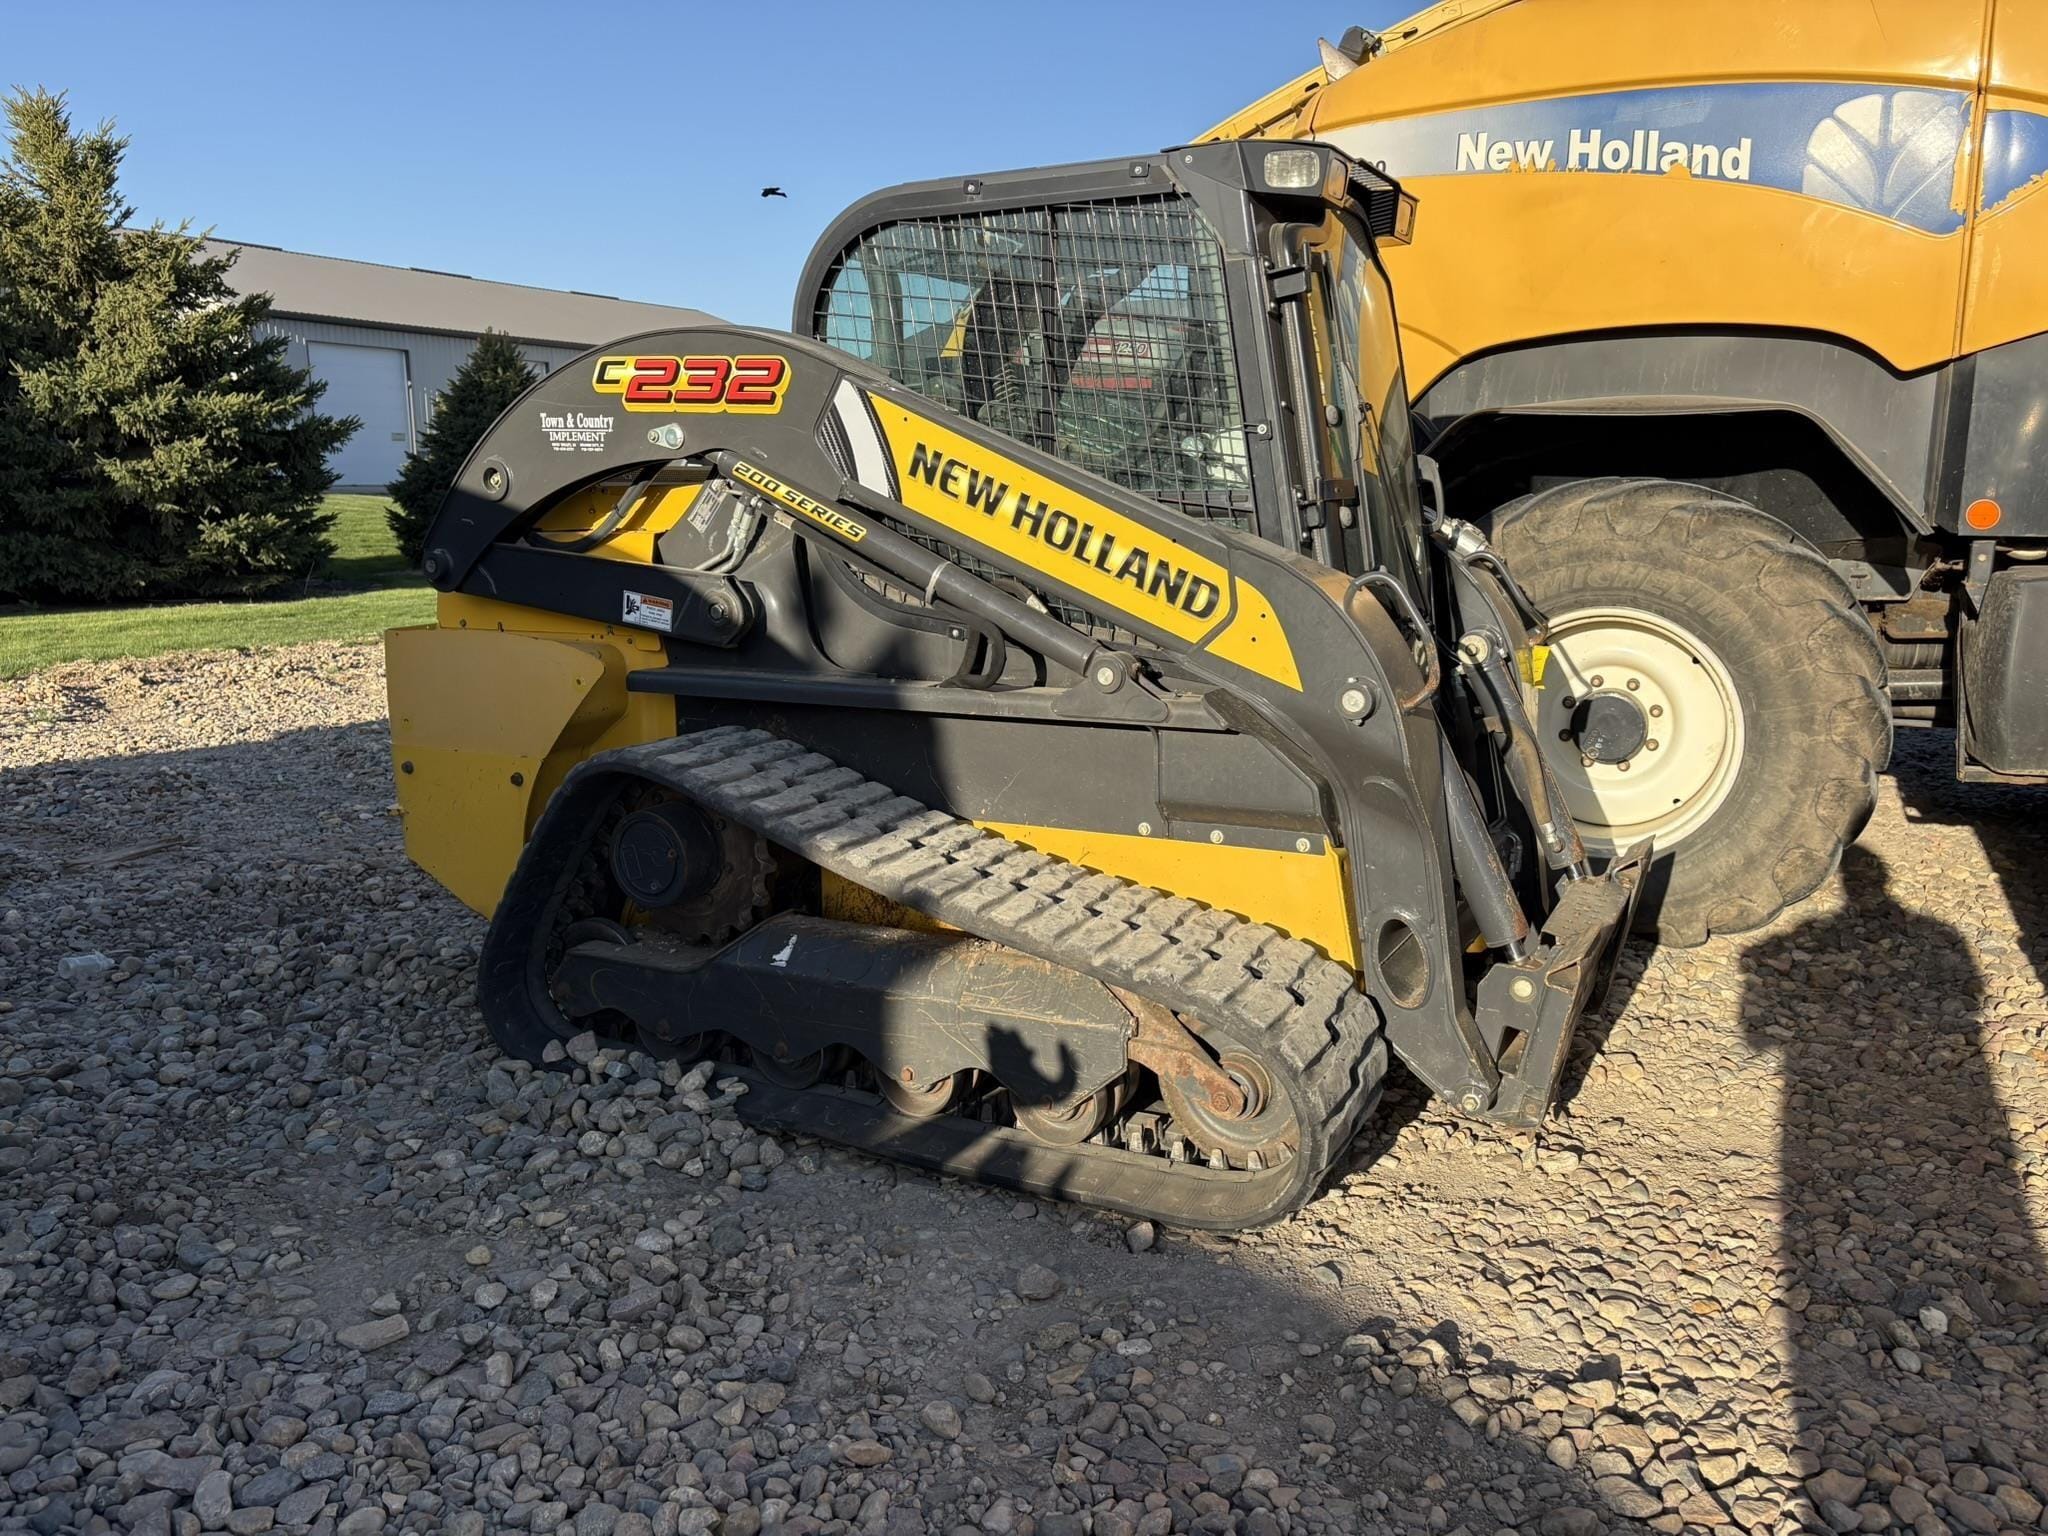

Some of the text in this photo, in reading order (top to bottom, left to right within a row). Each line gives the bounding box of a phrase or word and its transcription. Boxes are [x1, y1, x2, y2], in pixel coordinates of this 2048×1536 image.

[1457, 129, 1752, 180] New Holland
[540, 412, 614, 432] Town & Country
[549, 431, 606, 442] IMPLEMENT
[734, 463, 865, 538] 200 SERIES
[908, 442, 1221, 619] NEW HOLLAND
